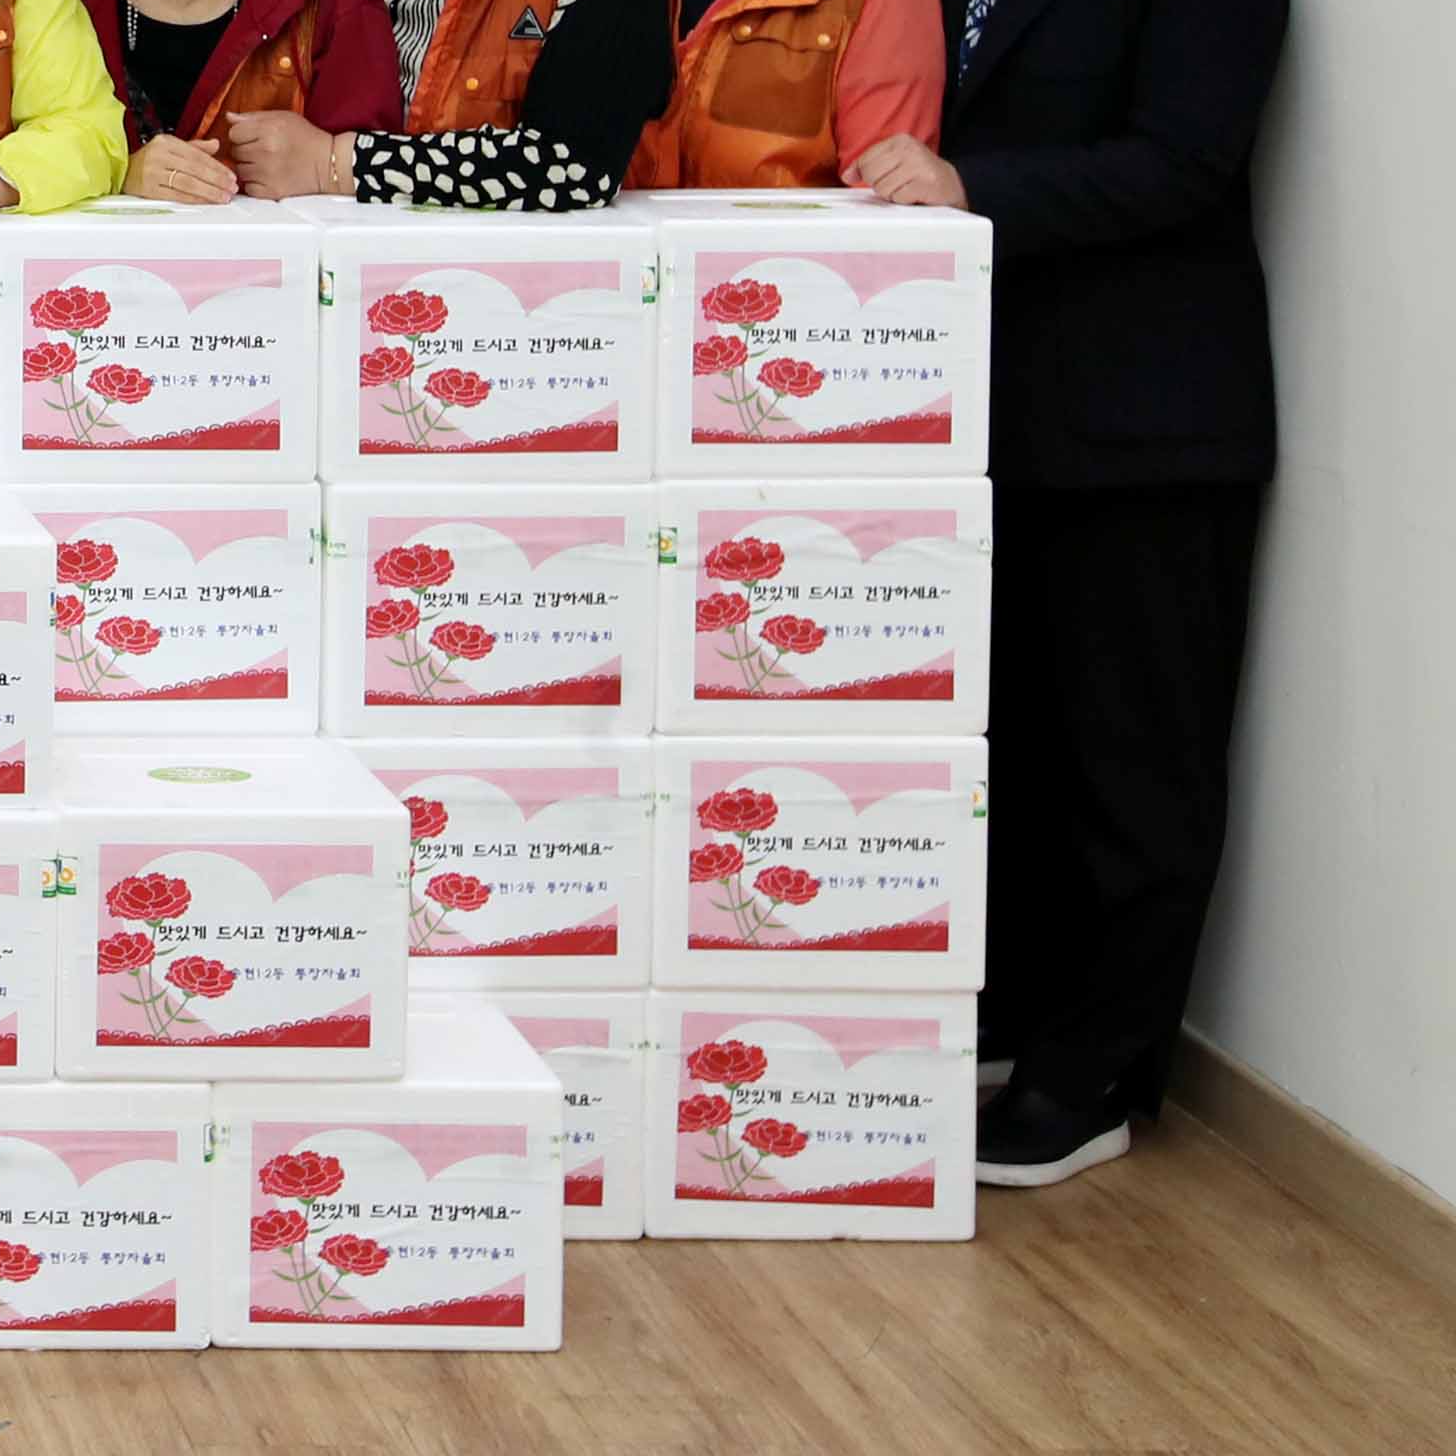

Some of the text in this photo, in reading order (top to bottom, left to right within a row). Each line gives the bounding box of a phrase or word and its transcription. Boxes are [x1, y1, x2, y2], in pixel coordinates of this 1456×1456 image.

[156, 924, 206, 941] 맛있게
[215, 925, 265, 940] 드시고
[22, 1210, 71, 1225] 드시고
[310, 1203, 360, 1220] 맛있게
[370, 1204, 418, 1219] 드시고
